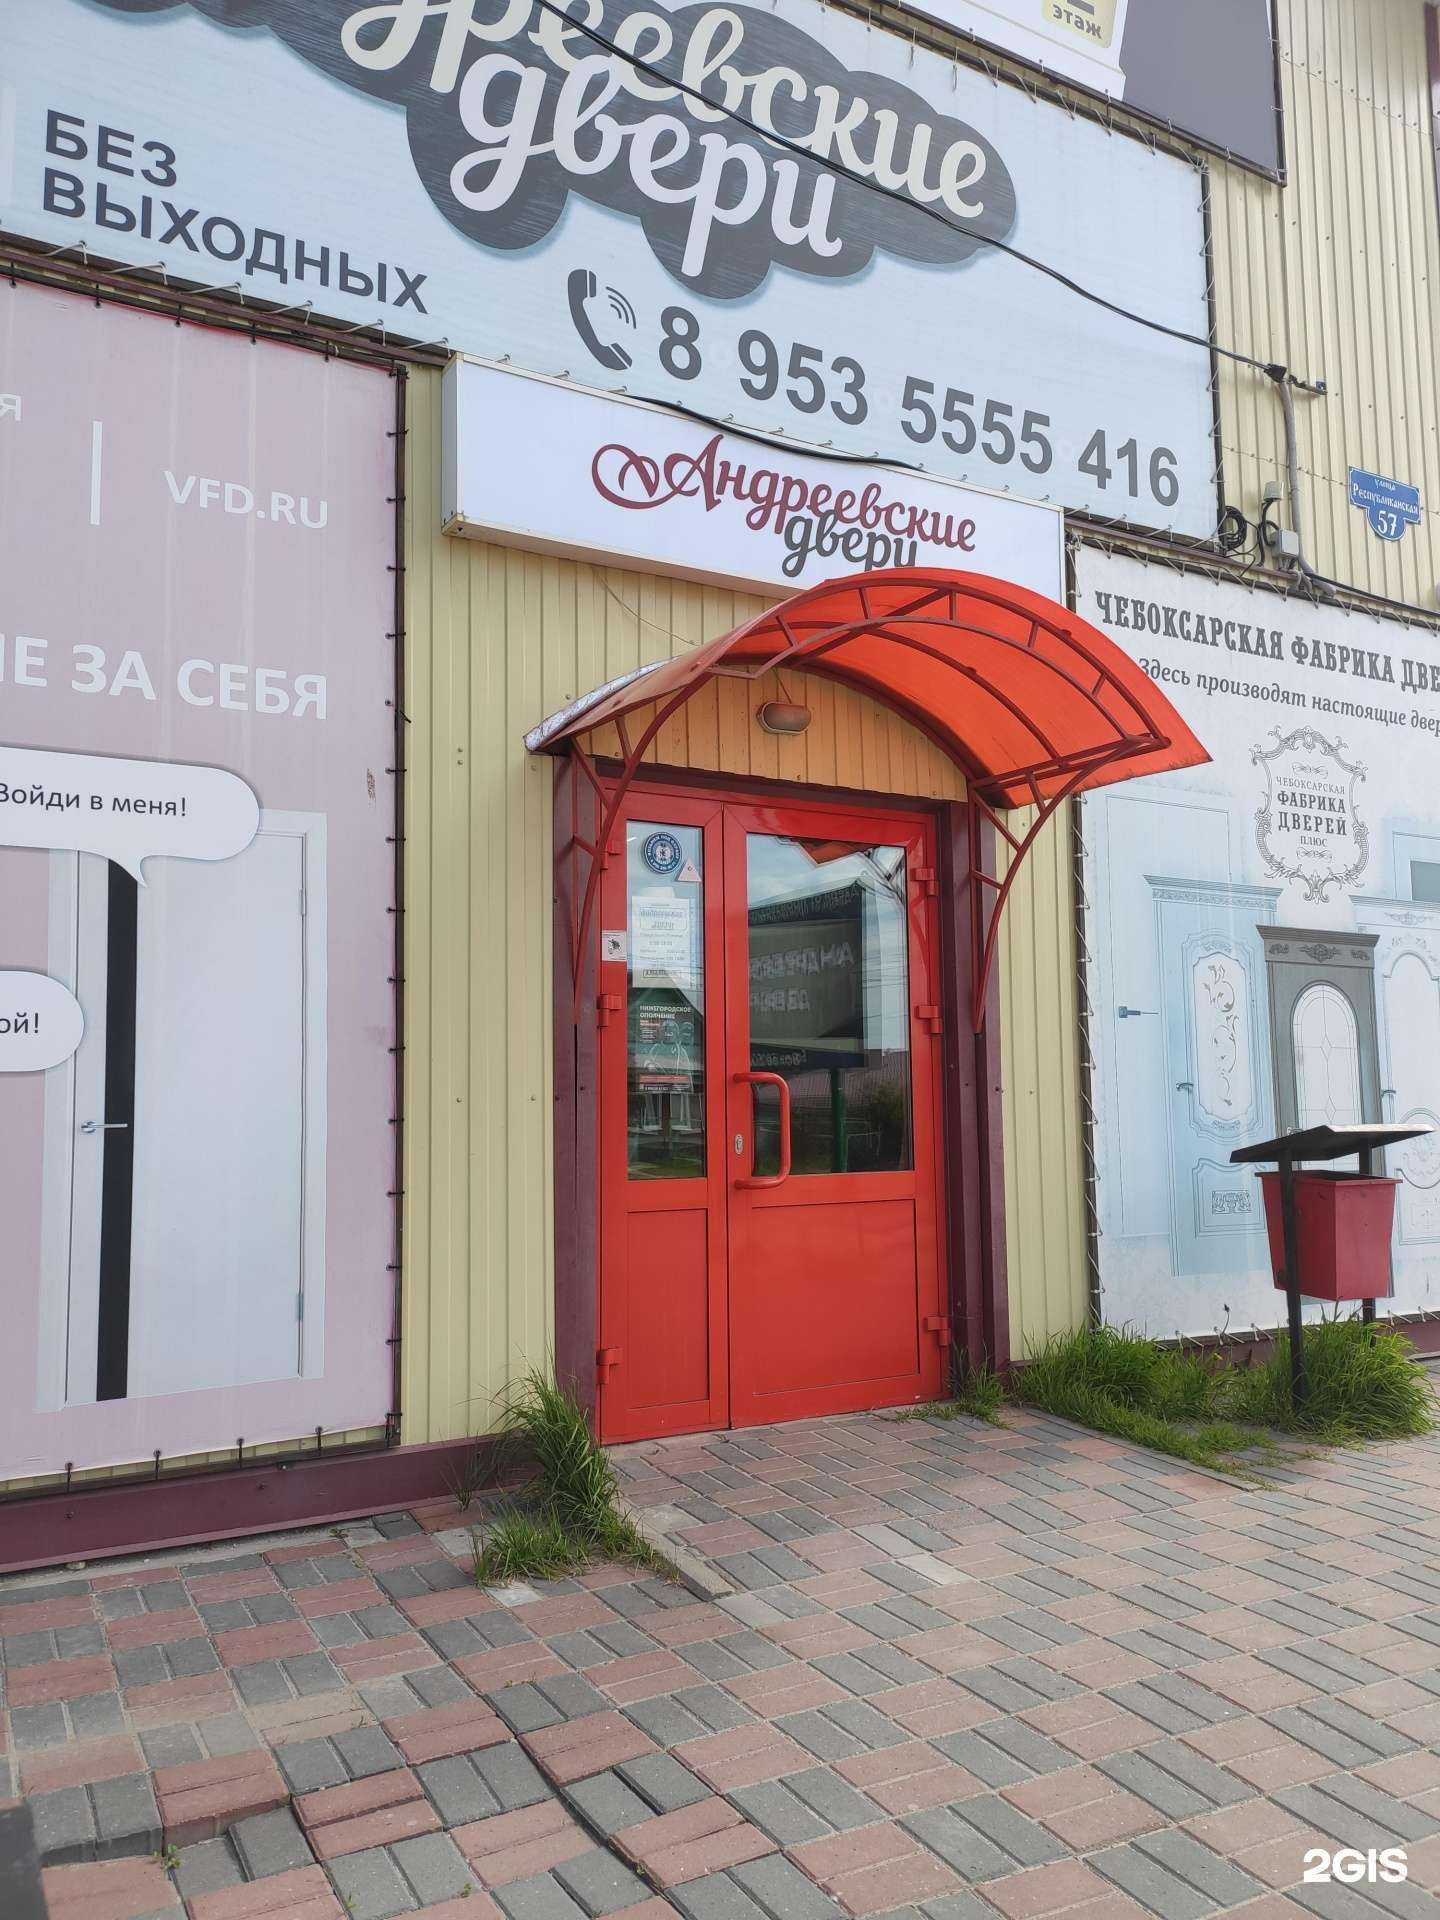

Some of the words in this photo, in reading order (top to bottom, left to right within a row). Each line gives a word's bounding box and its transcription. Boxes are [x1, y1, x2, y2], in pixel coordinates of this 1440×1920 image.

[1052, 4, 1103, 39] этаж
[45, 109, 178, 188] БЕЗ
[450, 54, 842, 277] двери
[43, 166, 430, 315] ВЫХОДНЫХ
[658, 306, 702, 381] 8
[737, 329, 869, 426] 953
[901, 375, 1053, 474] 5555
[1078, 429, 1180, 506] 416
[163, 470, 328, 529] VFD.RU
[591, 433, 976, 552] Андреевские
[1377, 510, 1397, 537] 57
[781, 508, 918, 578] двери
[1094, 590, 1284, 661] ЧЕБОКСАРСКАЯ
[1291, 635, 1396, 684] ФАБРИКА
[1400, 658, 1440, 694] ДВЕ
[71, 643, 157, 701] ЗА
[176, 658, 328, 720] СЕБЯ
[1138, 657, 1191, 686] Здесь
[1196, 672, 1307, 709] производят
[1311, 695, 1407, 728] настоящие
[90, 795, 104, 811] в
[112, 796, 187, 817] меня!
[1276, 776, 1345, 795] ЧЕБОКСАРСКАЯ
[1277, 790, 1346, 814] ФАБРИКА
[1278, 811, 1347, 836] ДВЕРЕЙ
[1300, 835, 1328, 847] ПЛЮС
